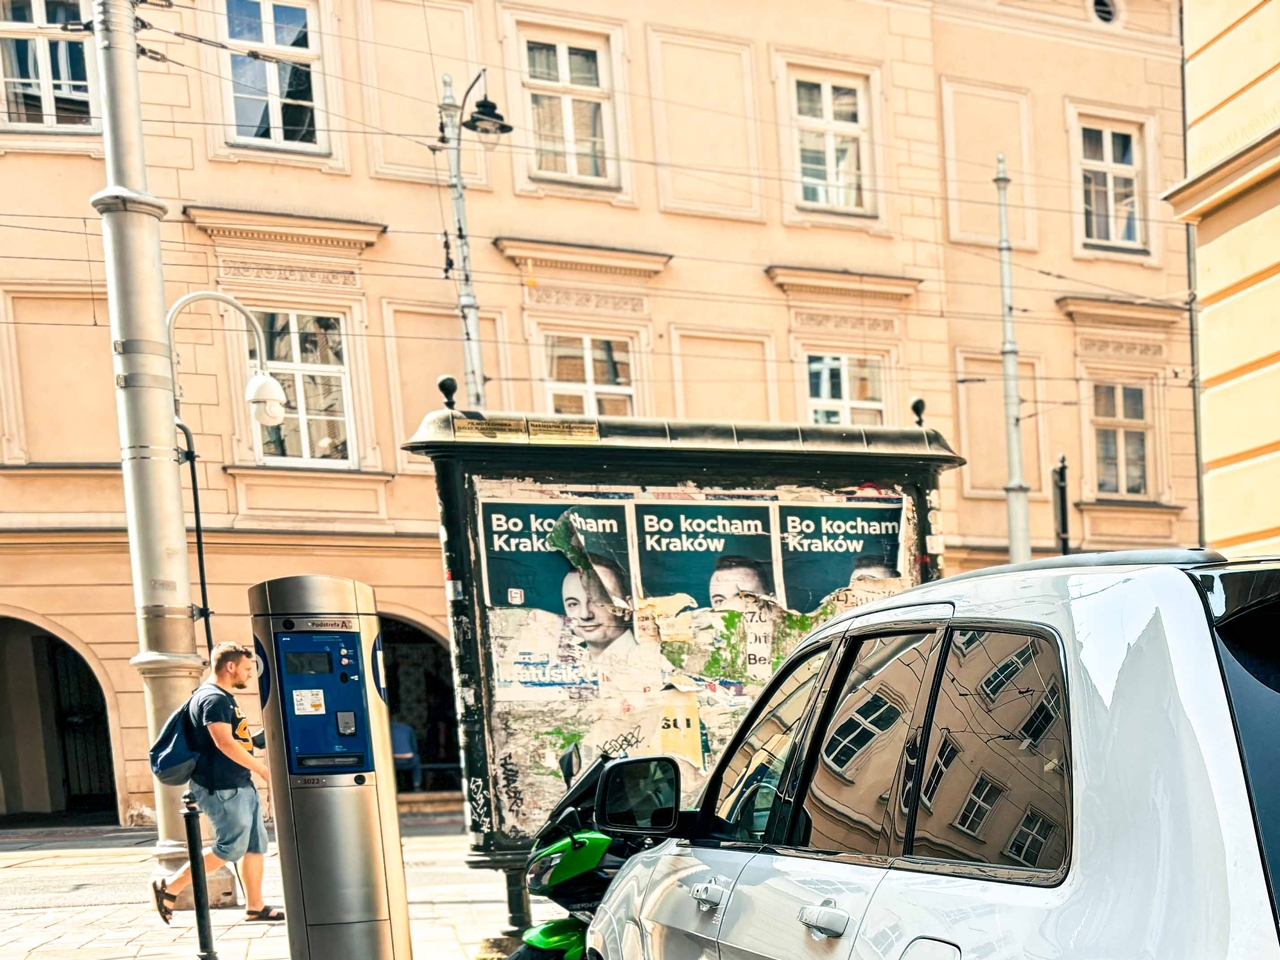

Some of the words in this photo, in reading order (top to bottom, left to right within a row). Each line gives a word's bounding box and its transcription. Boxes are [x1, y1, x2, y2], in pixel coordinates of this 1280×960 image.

[491, 513, 523, 532] Bo
[643, 515, 673, 532] Bo
[680, 515, 763, 534] kocham
[787, 516, 815, 533] Bo
[821, 516, 899, 535] kocham
[645, 534, 725, 552] Kraków
[788, 535, 864, 553] Kraków
[340, 621, 348, 629] A
